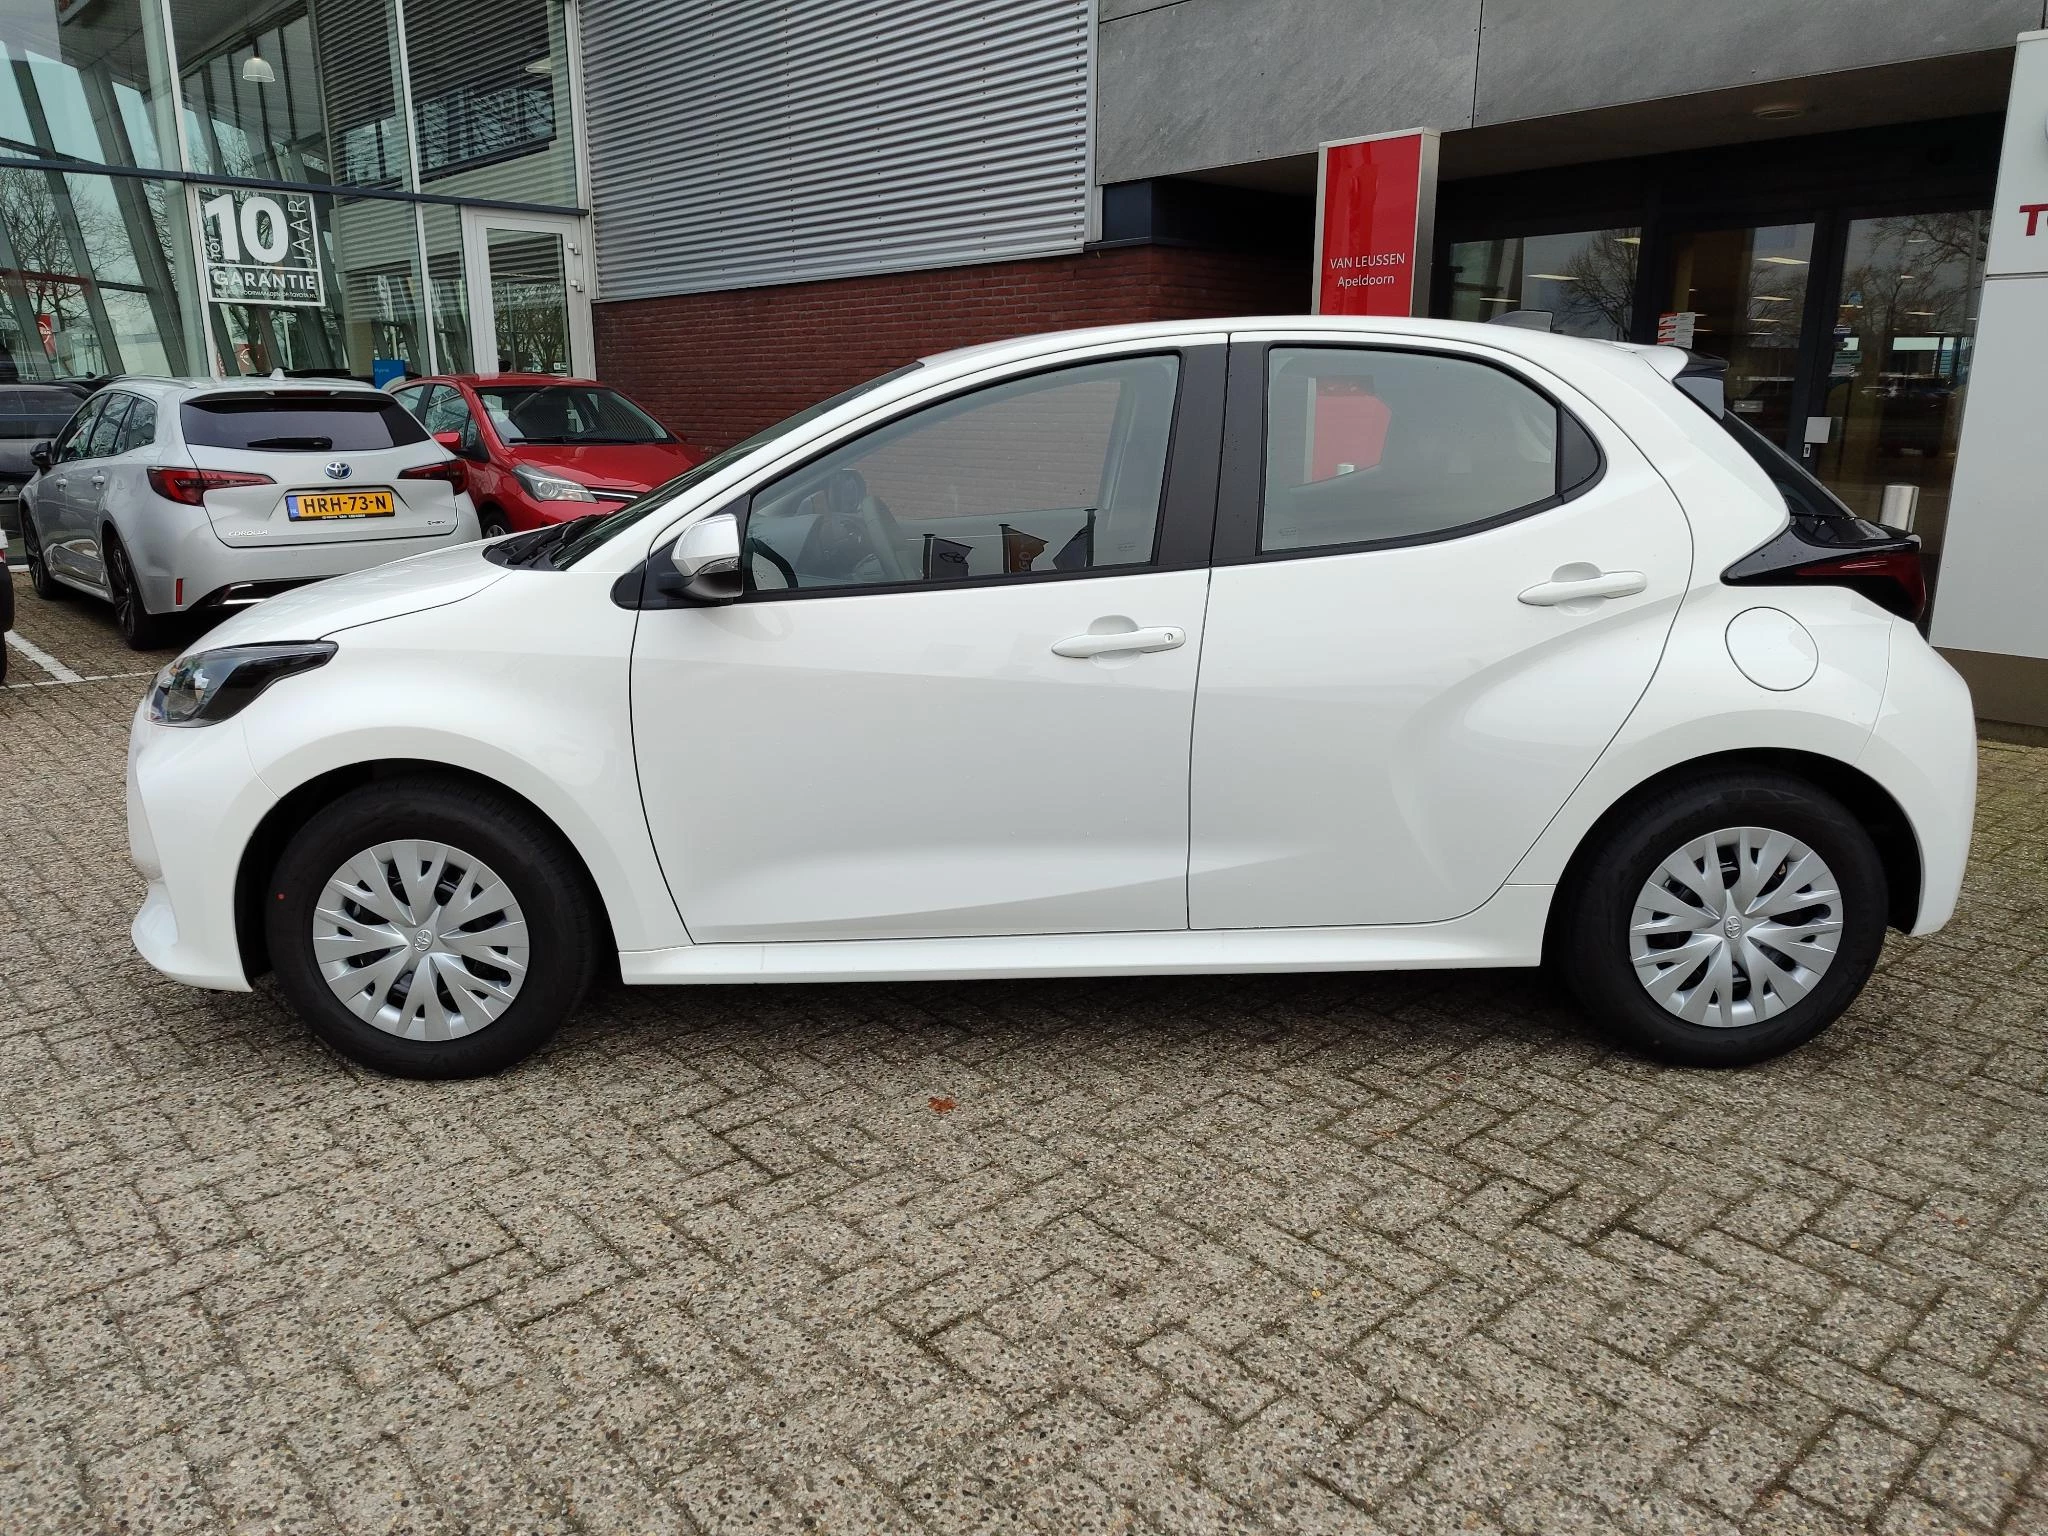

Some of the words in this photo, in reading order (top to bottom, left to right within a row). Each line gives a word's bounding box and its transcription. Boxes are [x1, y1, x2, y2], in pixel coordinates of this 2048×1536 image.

[204, 193, 289, 264] 10
[2019, 203, 2048, 237] T
[287, 200, 313, 265] JAAR
[208, 235, 222, 260] TOT
[1330, 257, 1352, 269] VAN
[1355, 252, 1405, 268] LEUSSEN
[213, 270, 316, 290] GARANTIE
[1337, 274, 1395, 289] Apeldoorn
[303, 495, 387, 514] HRH-73-N
